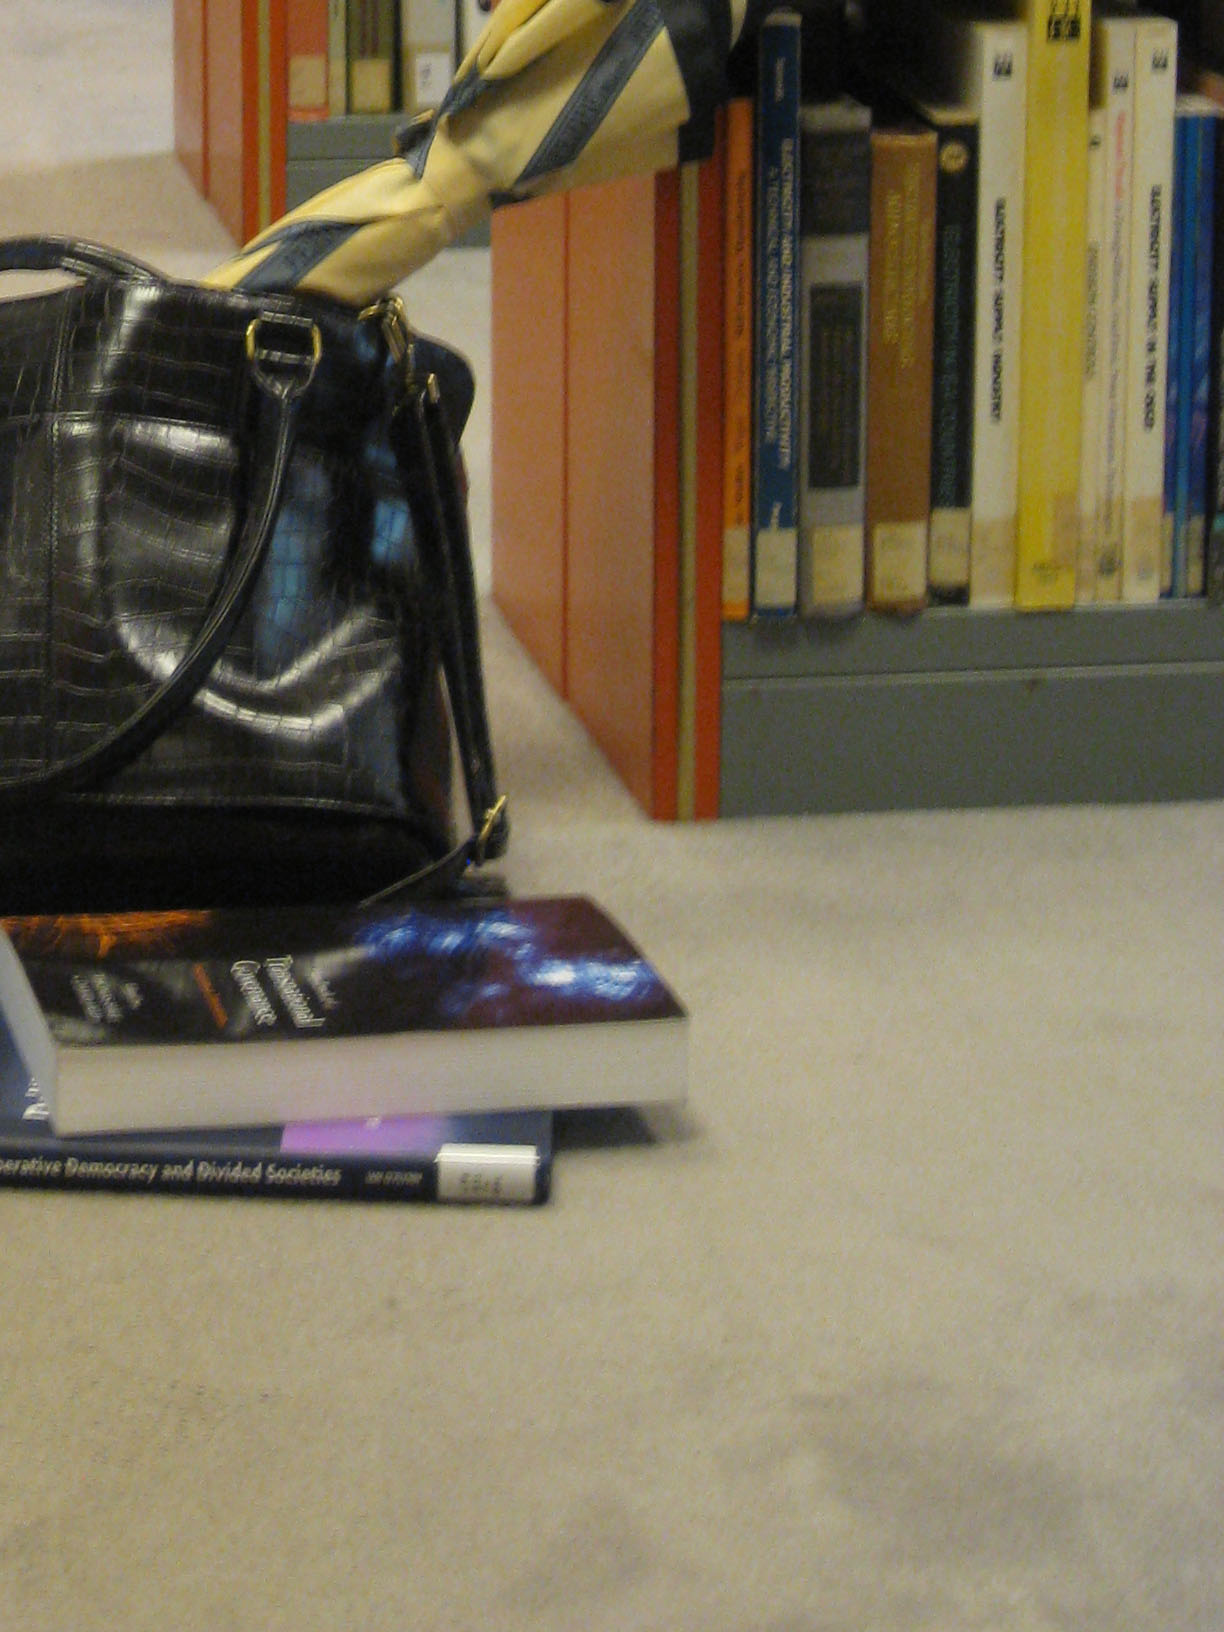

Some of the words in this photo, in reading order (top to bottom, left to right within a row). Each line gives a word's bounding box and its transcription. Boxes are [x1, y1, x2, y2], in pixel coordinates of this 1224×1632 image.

[780, 137, 794, 230] ELECTRICITY
[781, 233, 794, 266] AND
[994, 197, 1007, 283] ELECTRICITY
[1148, 184, 1163, 271] ELECTRICITY
[780, 269, 793, 357] INDUSTRIAL
[993, 290, 1005, 342] SUPPLY
[1147, 278, 1160, 332] SUPPLY
[991, 349, 1004, 424] INDUSTRY
[1145, 361, 1157, 386] THE
[778, 359, 793, 469] PRODUCTIVITY
[230, 960, 278, 1026] Governance
[264, 954, 326, 1028] Transnational
[64, 1156, 160, 1184] Democracy
[161, 1160, 194, 1182] and
[196, 1161, 263, 1183] Divided
[265, 1163, 342, 1186] Societies
